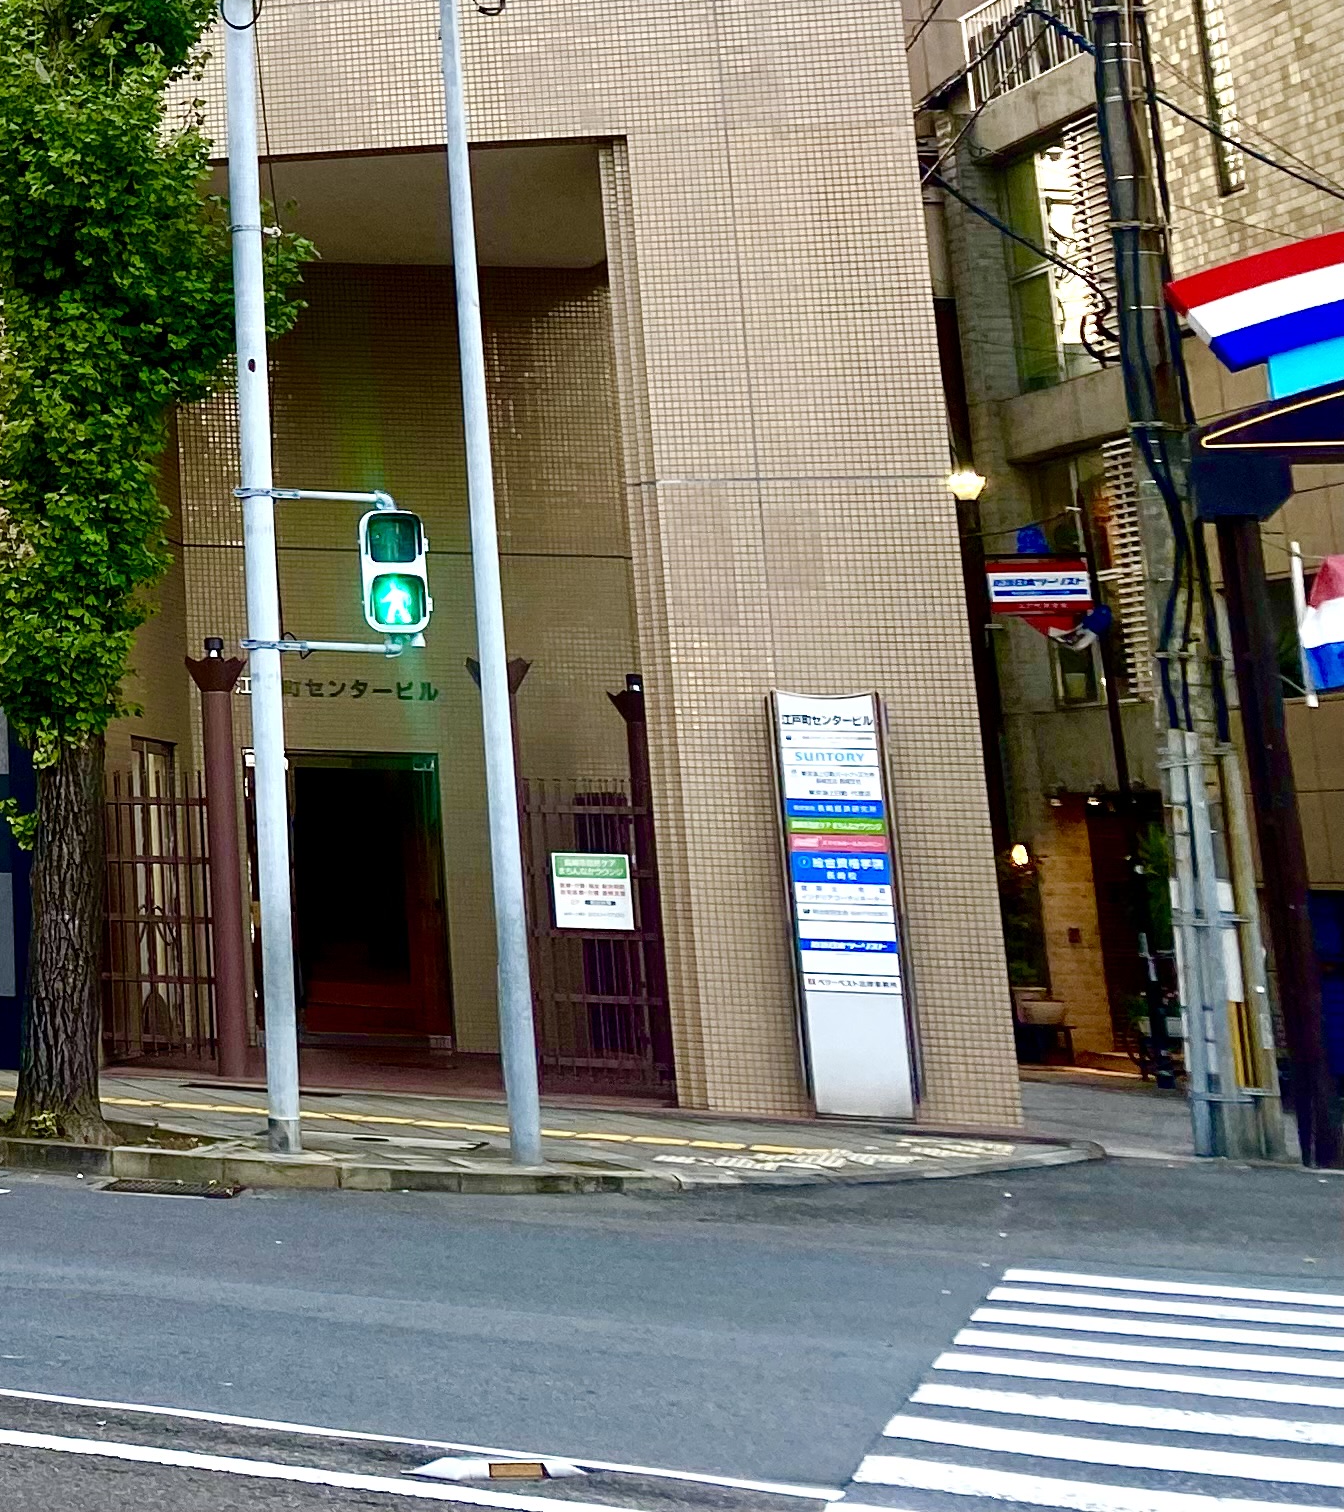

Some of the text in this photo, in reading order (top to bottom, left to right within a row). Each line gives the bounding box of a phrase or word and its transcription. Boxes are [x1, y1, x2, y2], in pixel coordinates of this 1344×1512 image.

[235, 676, 439, 702] 江町センタービル
[781, 714, 874, 727] 江戸町センタービル
[795, 752, 864, 762] SUNTORY
